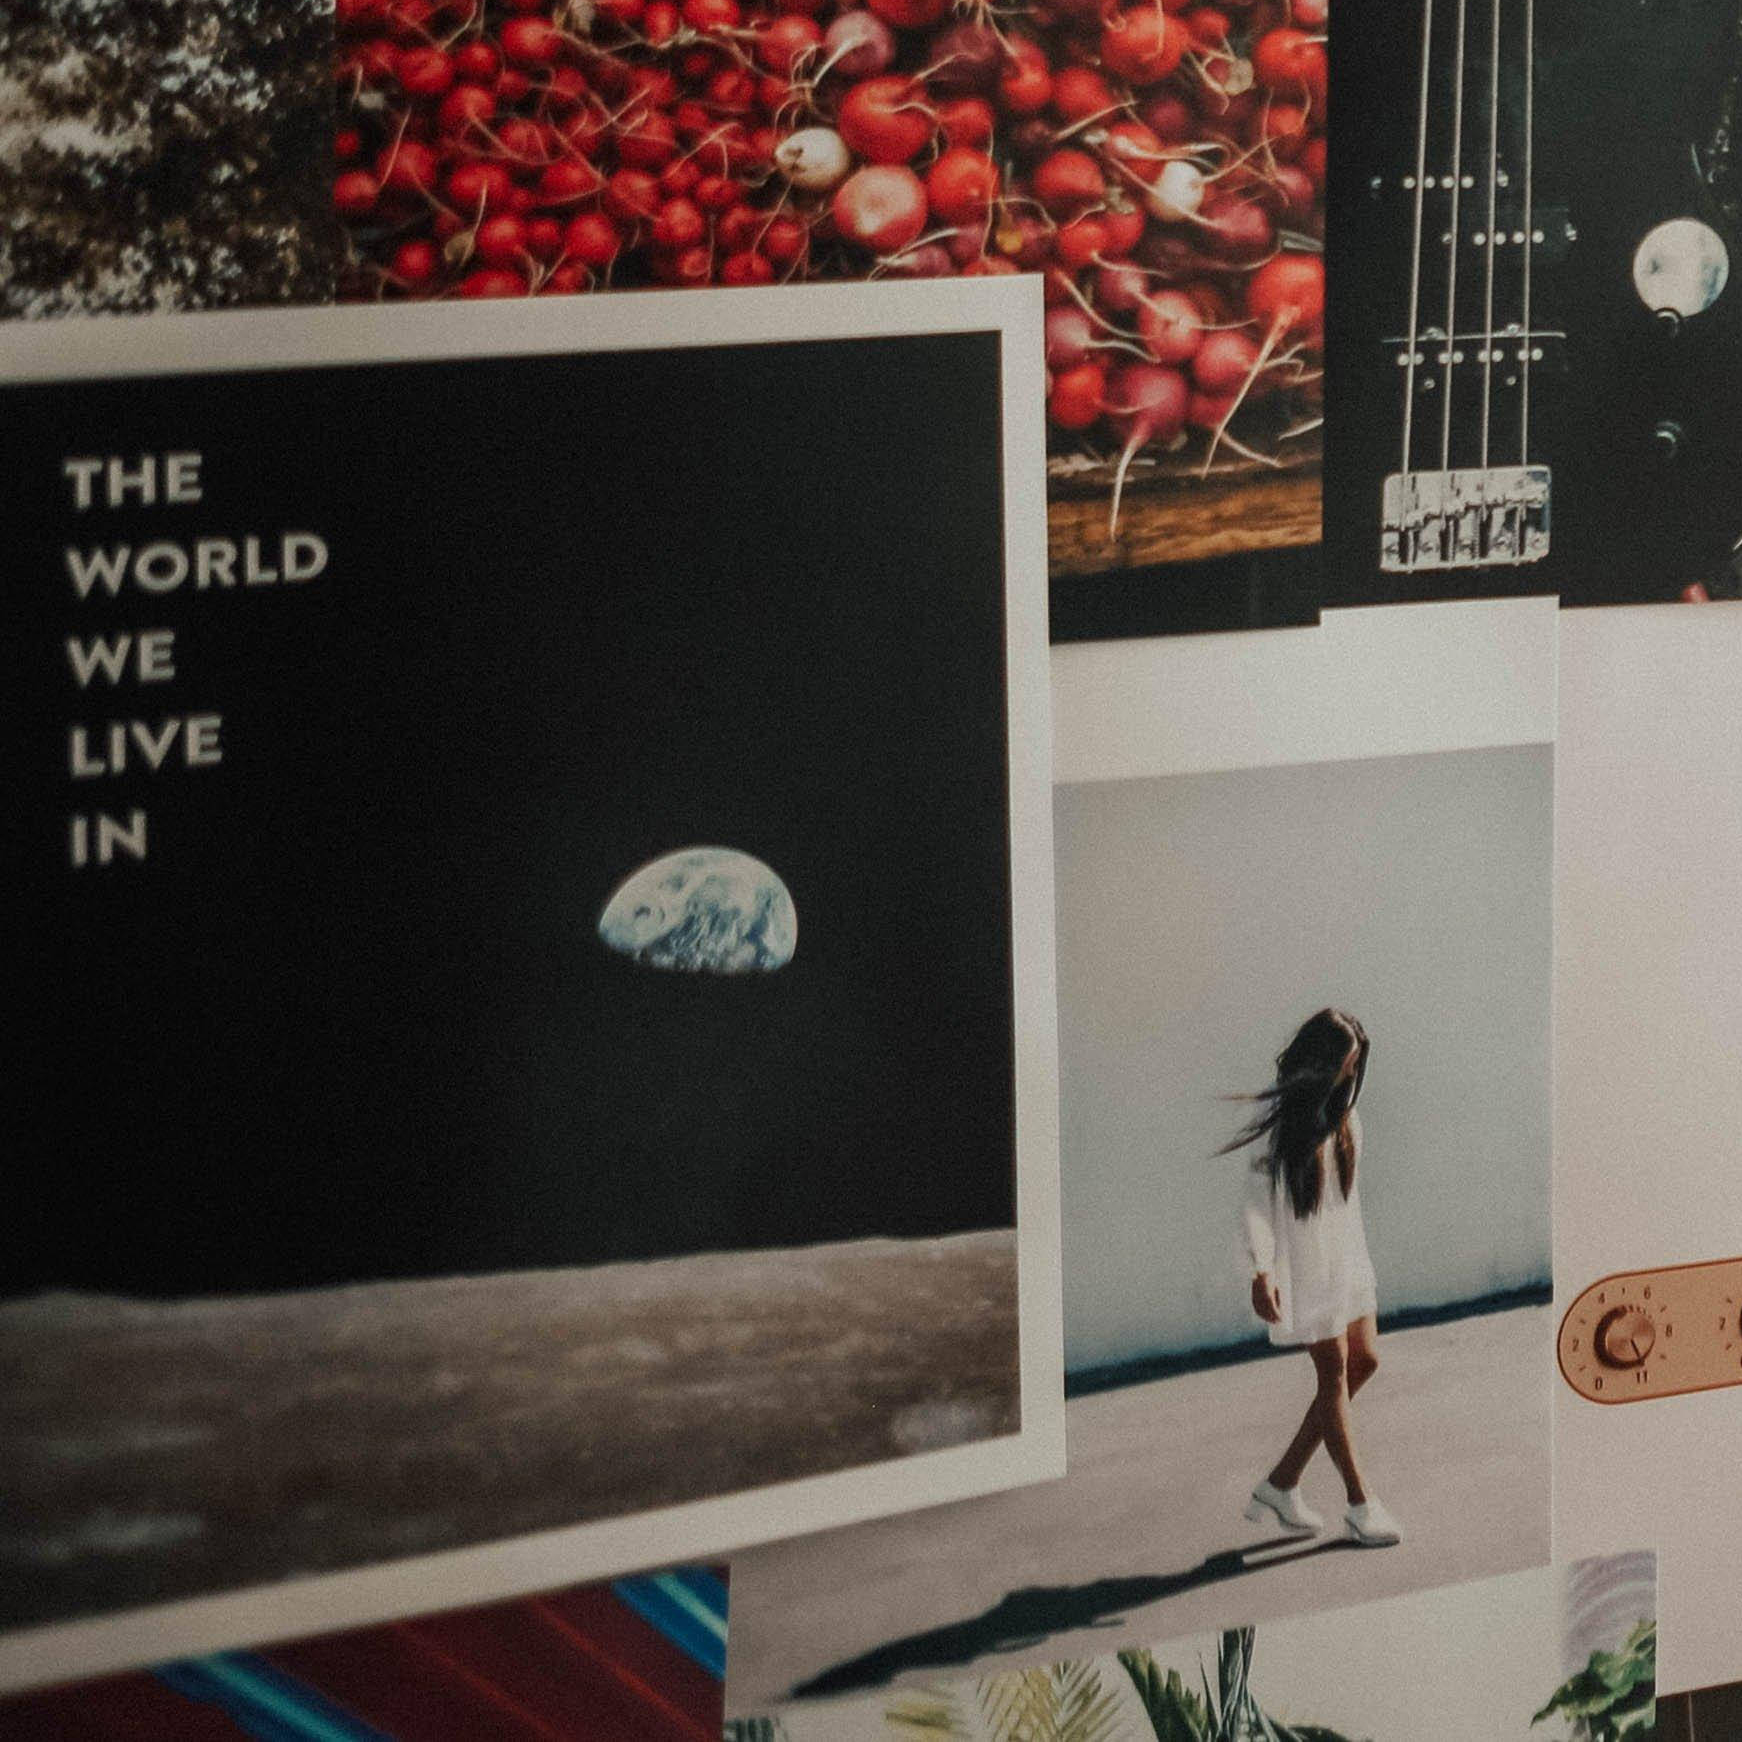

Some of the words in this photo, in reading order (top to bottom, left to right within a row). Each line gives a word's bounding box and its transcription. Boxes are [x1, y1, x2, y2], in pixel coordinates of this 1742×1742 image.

[65, 453, 203, 509] THE
[67, 533, 329, 597] WORLD
[68, 631, 175, 687] WE
[71, 715, 222, 776] LIVE
[71, 811, 146, 865] IN
[1636, 1370, 1648, 1384] 11
